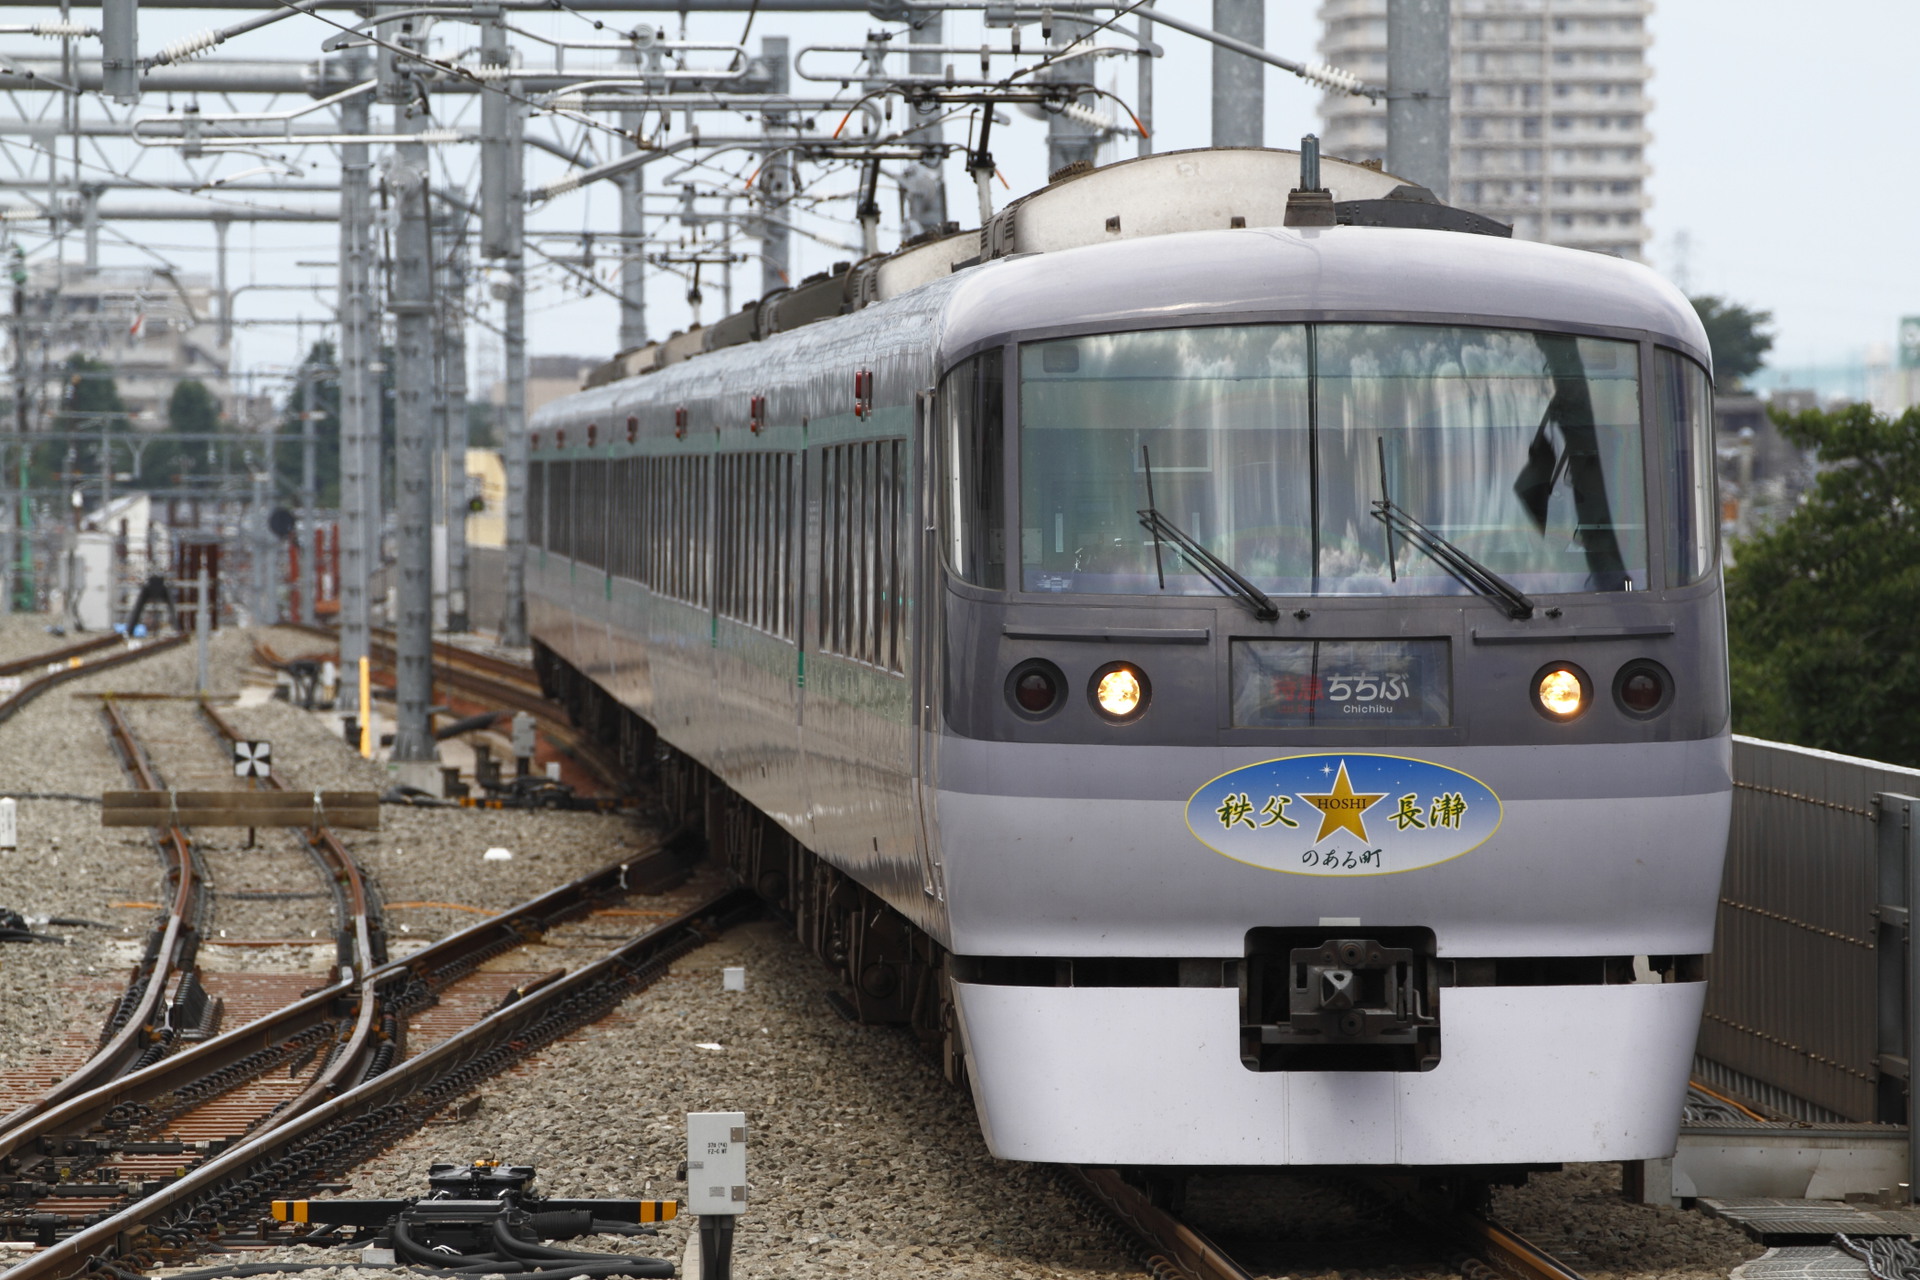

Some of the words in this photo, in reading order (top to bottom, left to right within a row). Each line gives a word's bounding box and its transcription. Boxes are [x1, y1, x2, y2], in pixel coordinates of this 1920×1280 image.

[1327, 672, 1410, 702] ちちぶ
[1343, 704, 1393, 714] Chichibu
[1215, 793, 1300, 830] 秩父
[1317, 797, 1367, 810] HOSHI
[1302, 848, 1382, 869] のある町
